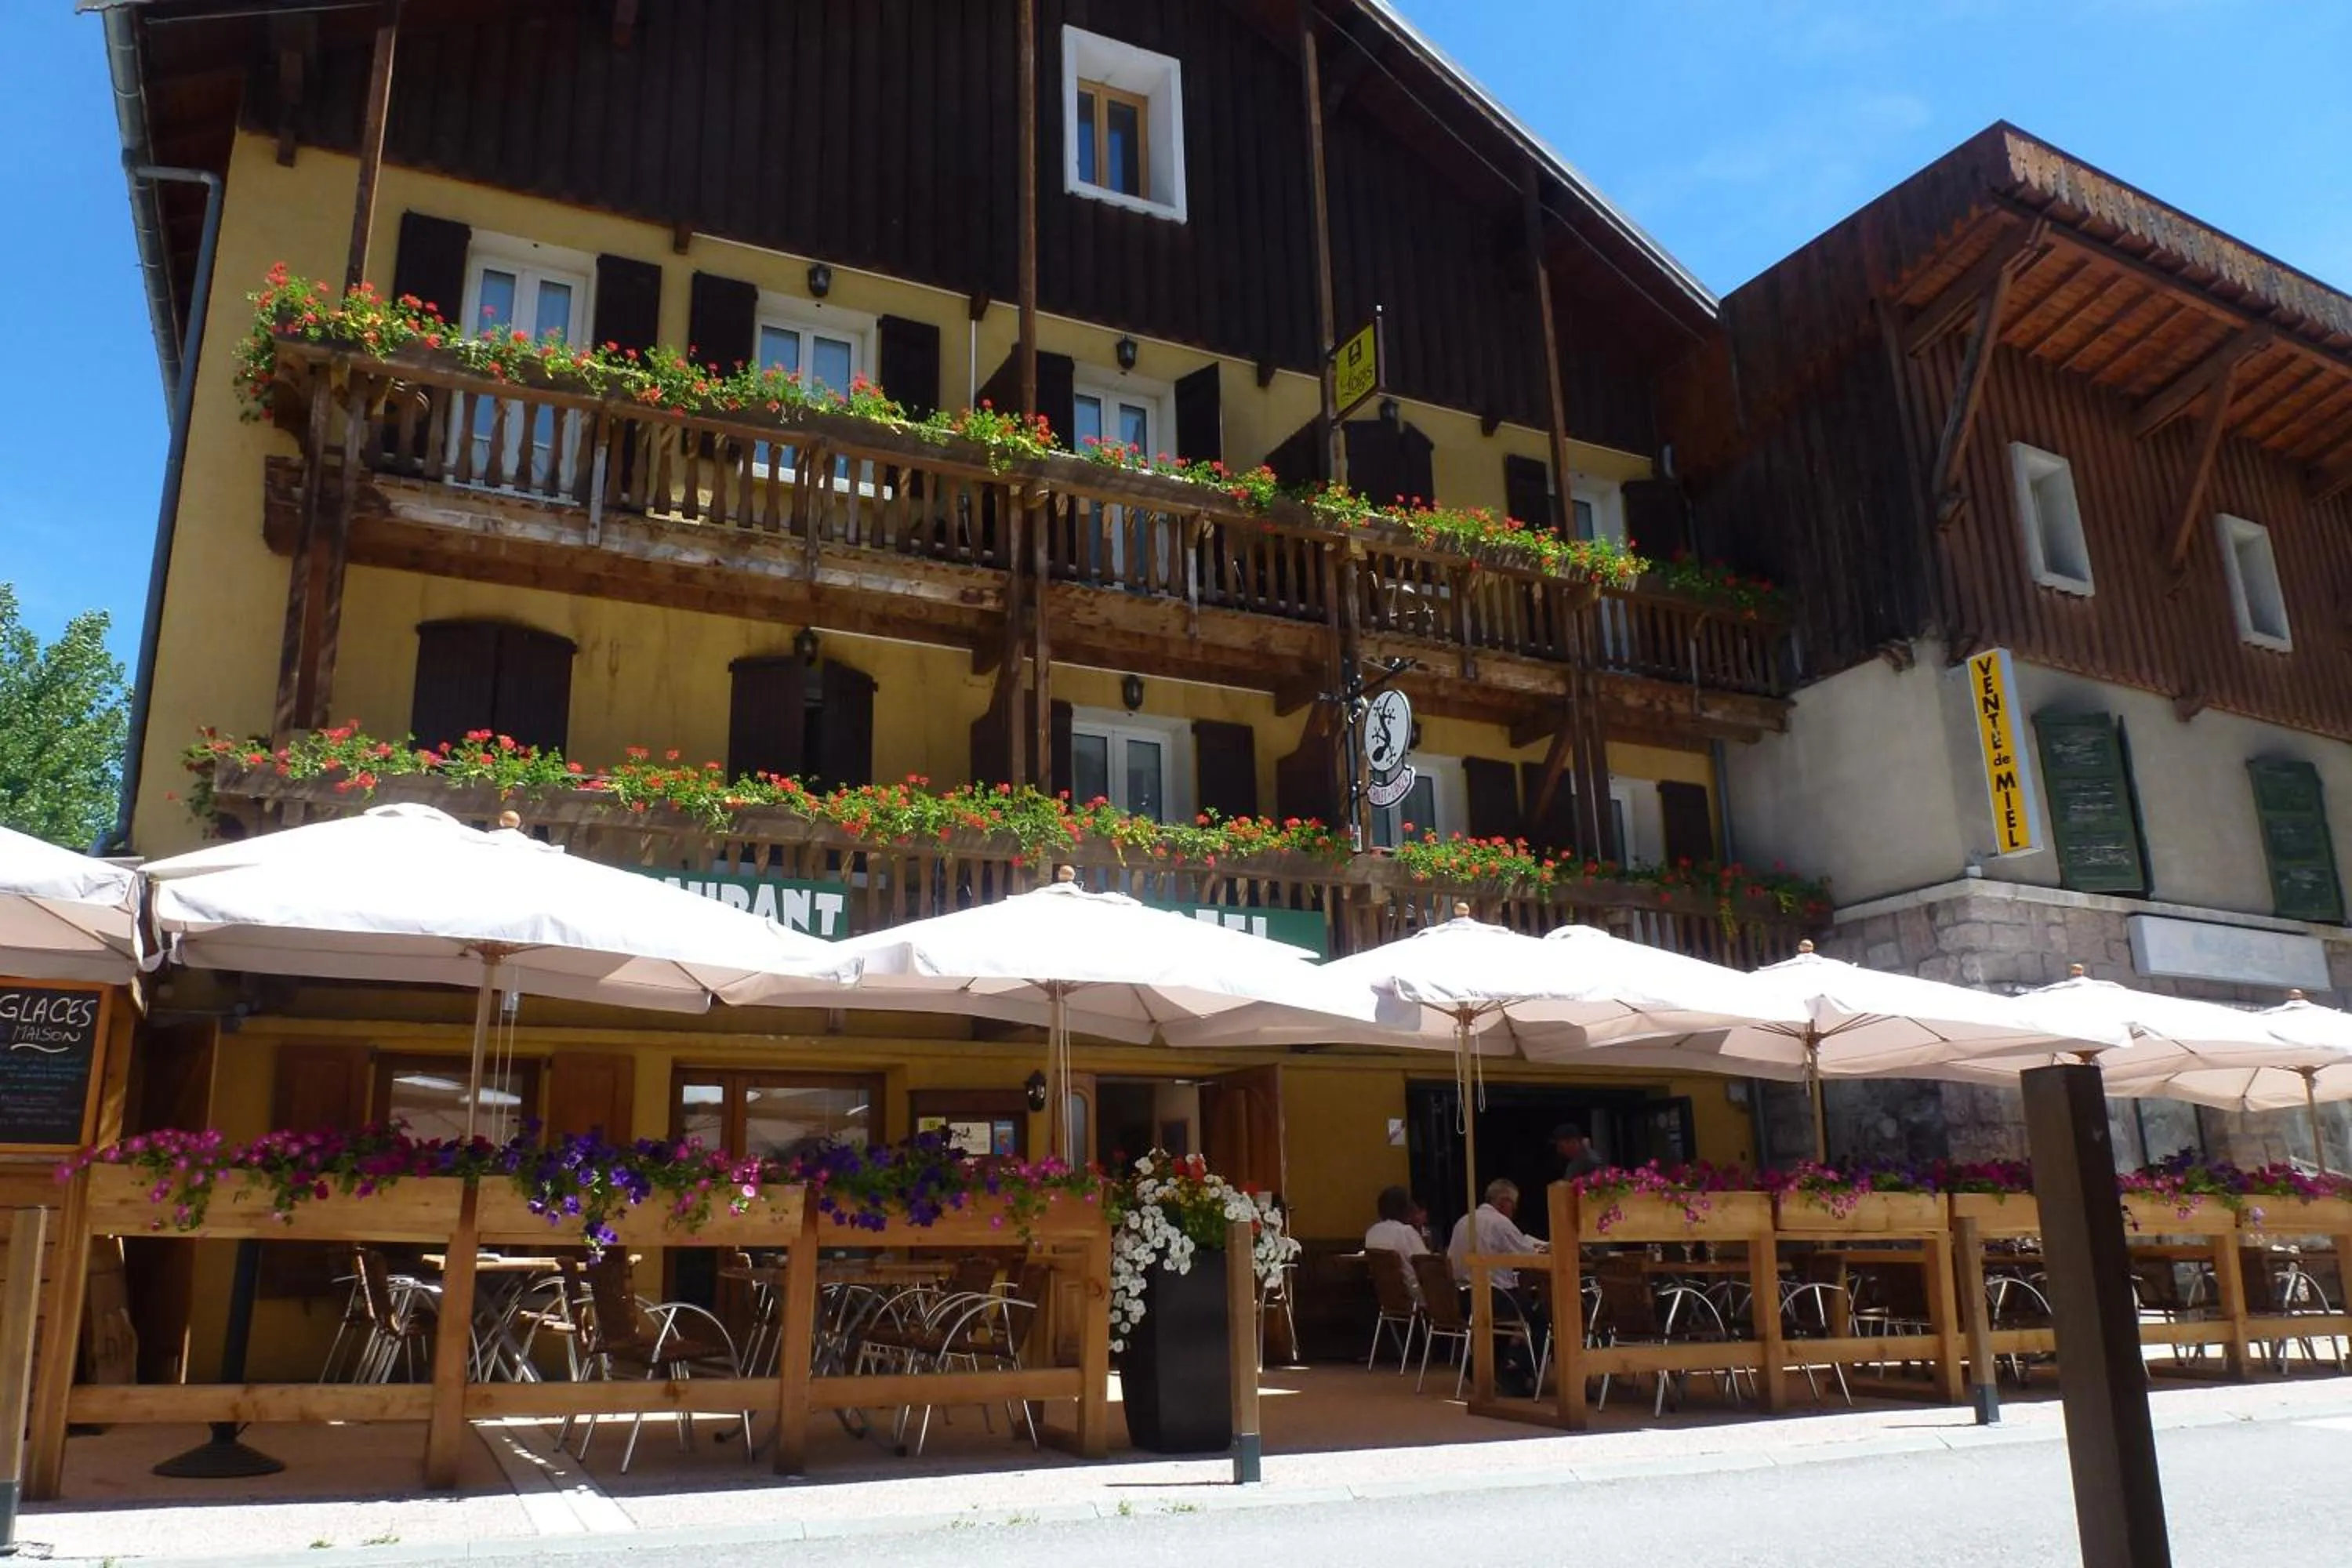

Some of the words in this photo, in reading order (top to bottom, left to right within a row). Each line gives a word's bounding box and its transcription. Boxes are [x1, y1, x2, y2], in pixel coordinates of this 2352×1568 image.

[1976, 656, 2001, 749] VENTE
[1994, 752, 2010, 766] de
[1995, 771, 2020, 848] MIEL
[0, 993, 97, 1027] GLACES
[13, 1025, 81, 1041] MAISON
